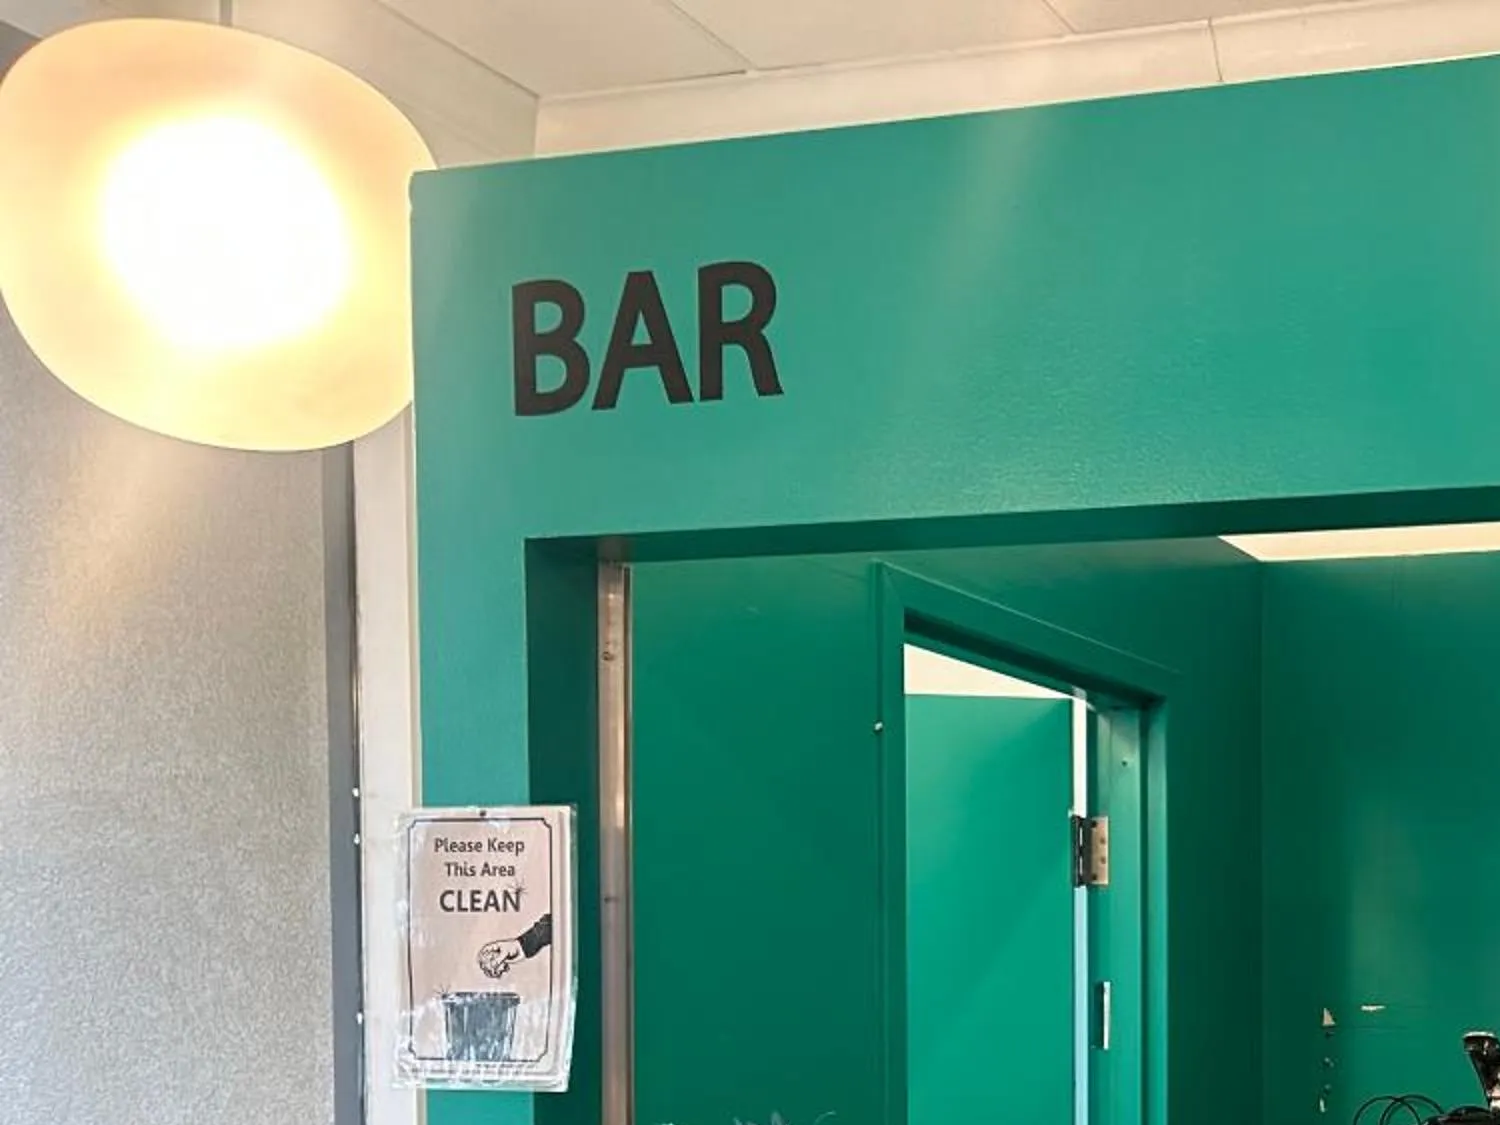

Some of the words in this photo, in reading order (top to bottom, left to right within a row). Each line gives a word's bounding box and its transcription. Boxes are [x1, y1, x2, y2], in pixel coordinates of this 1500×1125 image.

[511, 260, 784, 416] BAR
[434, 837, 483, 853] Please
[487, 837, 525, 857] Keep
[444, 861, 477, 877] This
[480, 861, 516, 877] Area
[439, 888, 521, 912] CLEAN
